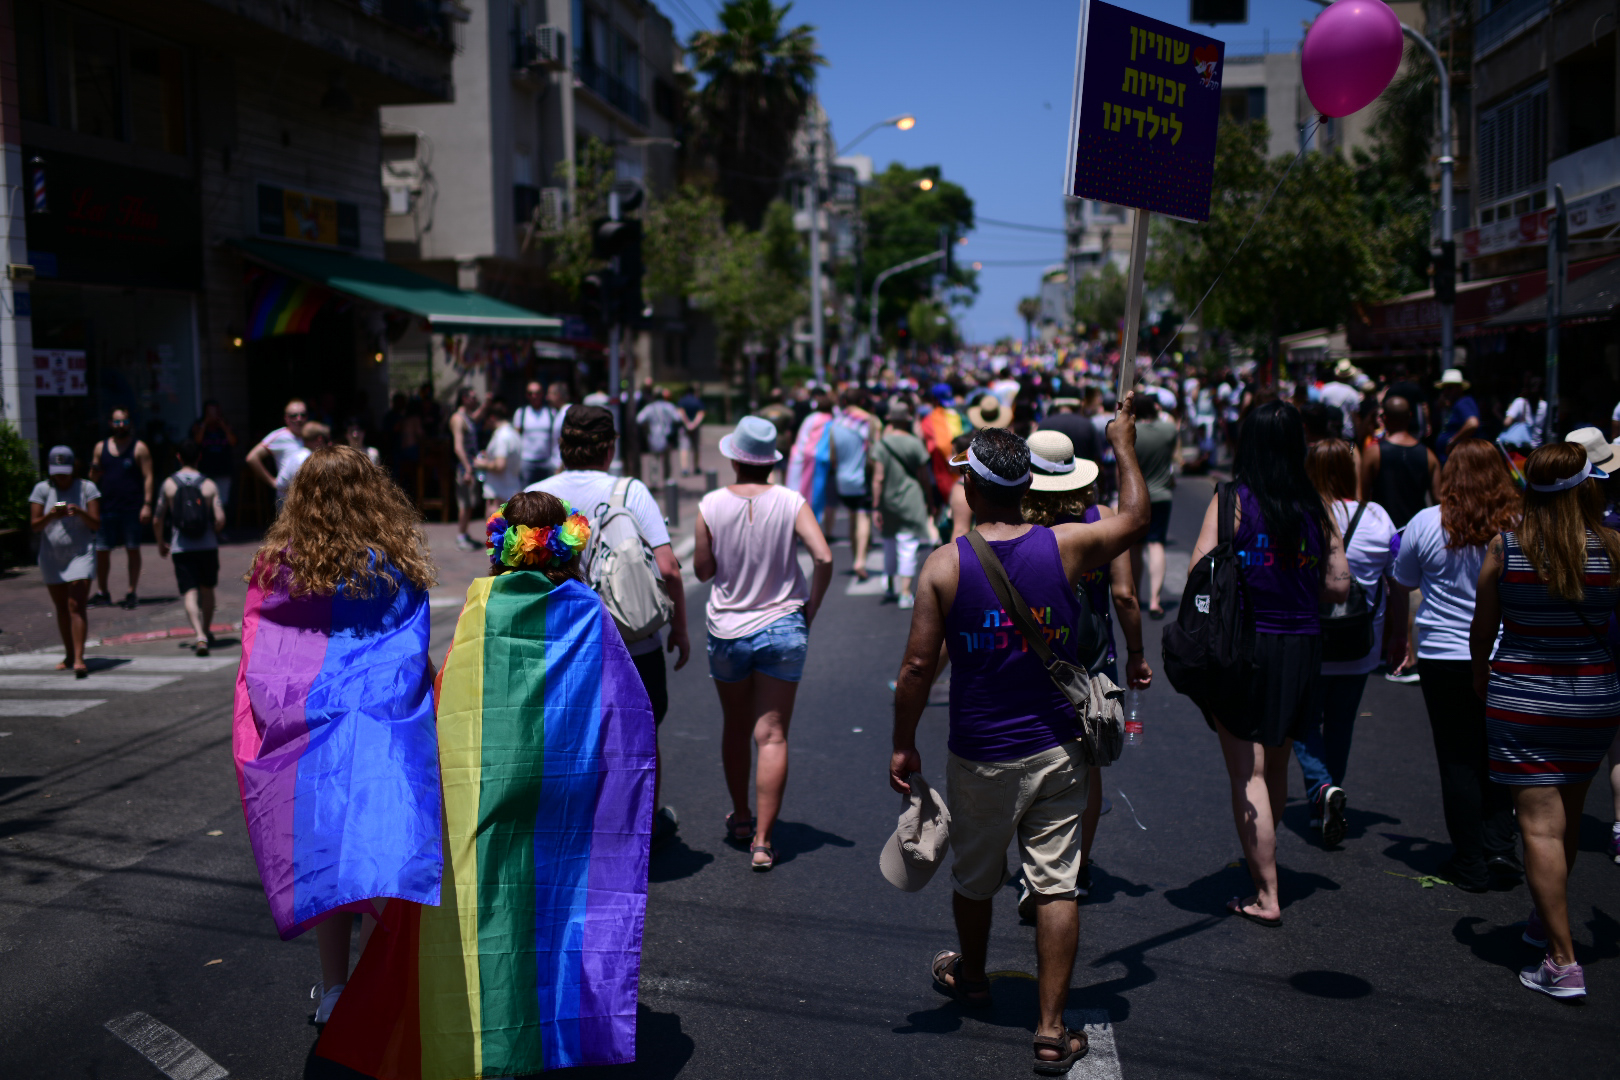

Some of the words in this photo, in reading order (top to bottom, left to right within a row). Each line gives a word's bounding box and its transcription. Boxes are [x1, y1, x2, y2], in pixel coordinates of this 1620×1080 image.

[1130, 25, 1190, 65] שוויון
[1122, 67, 1186, 108] זכויות
[1102, 101, 1183, 146] לילדינו
[959, 631, 1009, 653] כמוך
[1014, 625, 1070, 653] לילך
